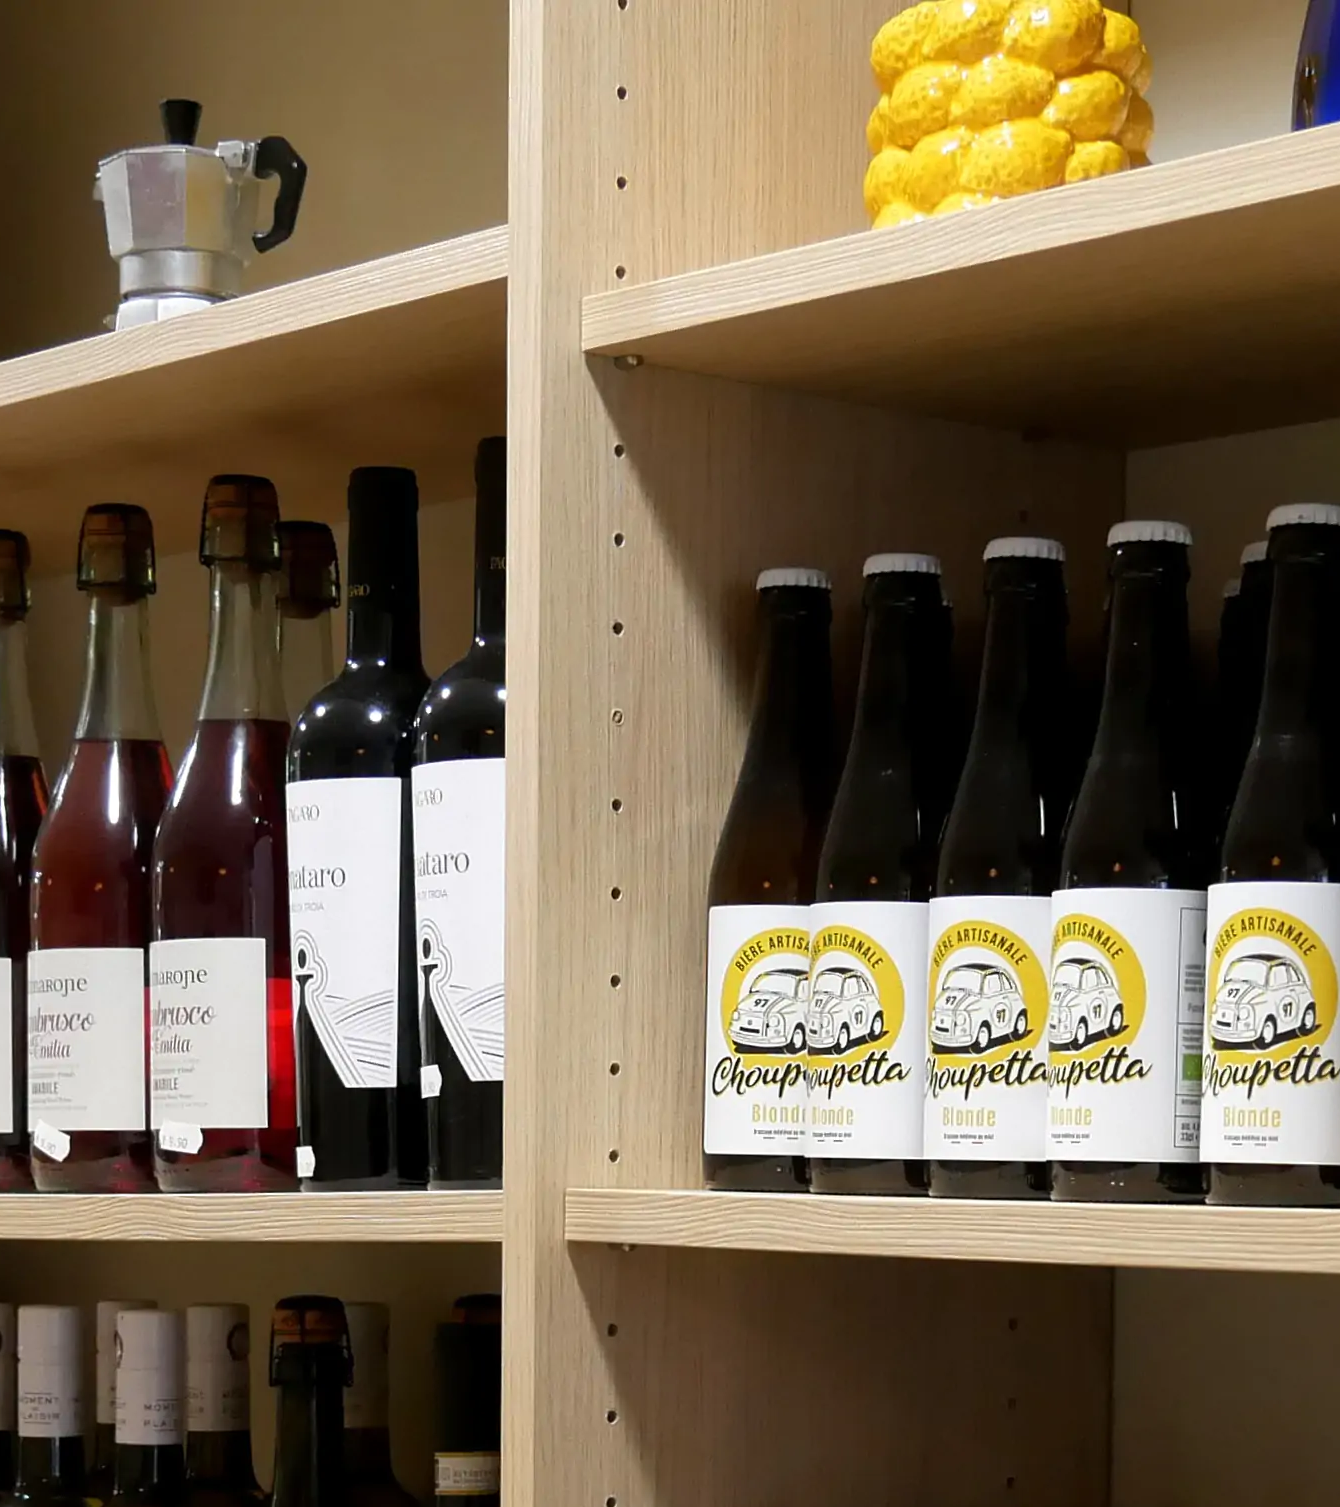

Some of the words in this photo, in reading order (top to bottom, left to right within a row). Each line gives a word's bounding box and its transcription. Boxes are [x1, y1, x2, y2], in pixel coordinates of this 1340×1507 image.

[956, 928, 1028, 967] ARTISANALE
[1061, 921, 1124, 960] ARTISANALE
[1240, 915, 1317, 957] ARTISANALE
[734, 940, 765, 973] BIÈRE
[822, 931, 884, 971] ARTISANALE
[753, 998, 768, 1008] 97
[1227, 988, 1240, 998] 97
[996, 1008, 1006, 1023] 97
[1282, 1002, 1294, 1019] 97
[712, 1056, 807, 1099] Choup
[942, 1106, 996, 1127] Blonde
[1223, 1106, 1282, 1128] Blonde
